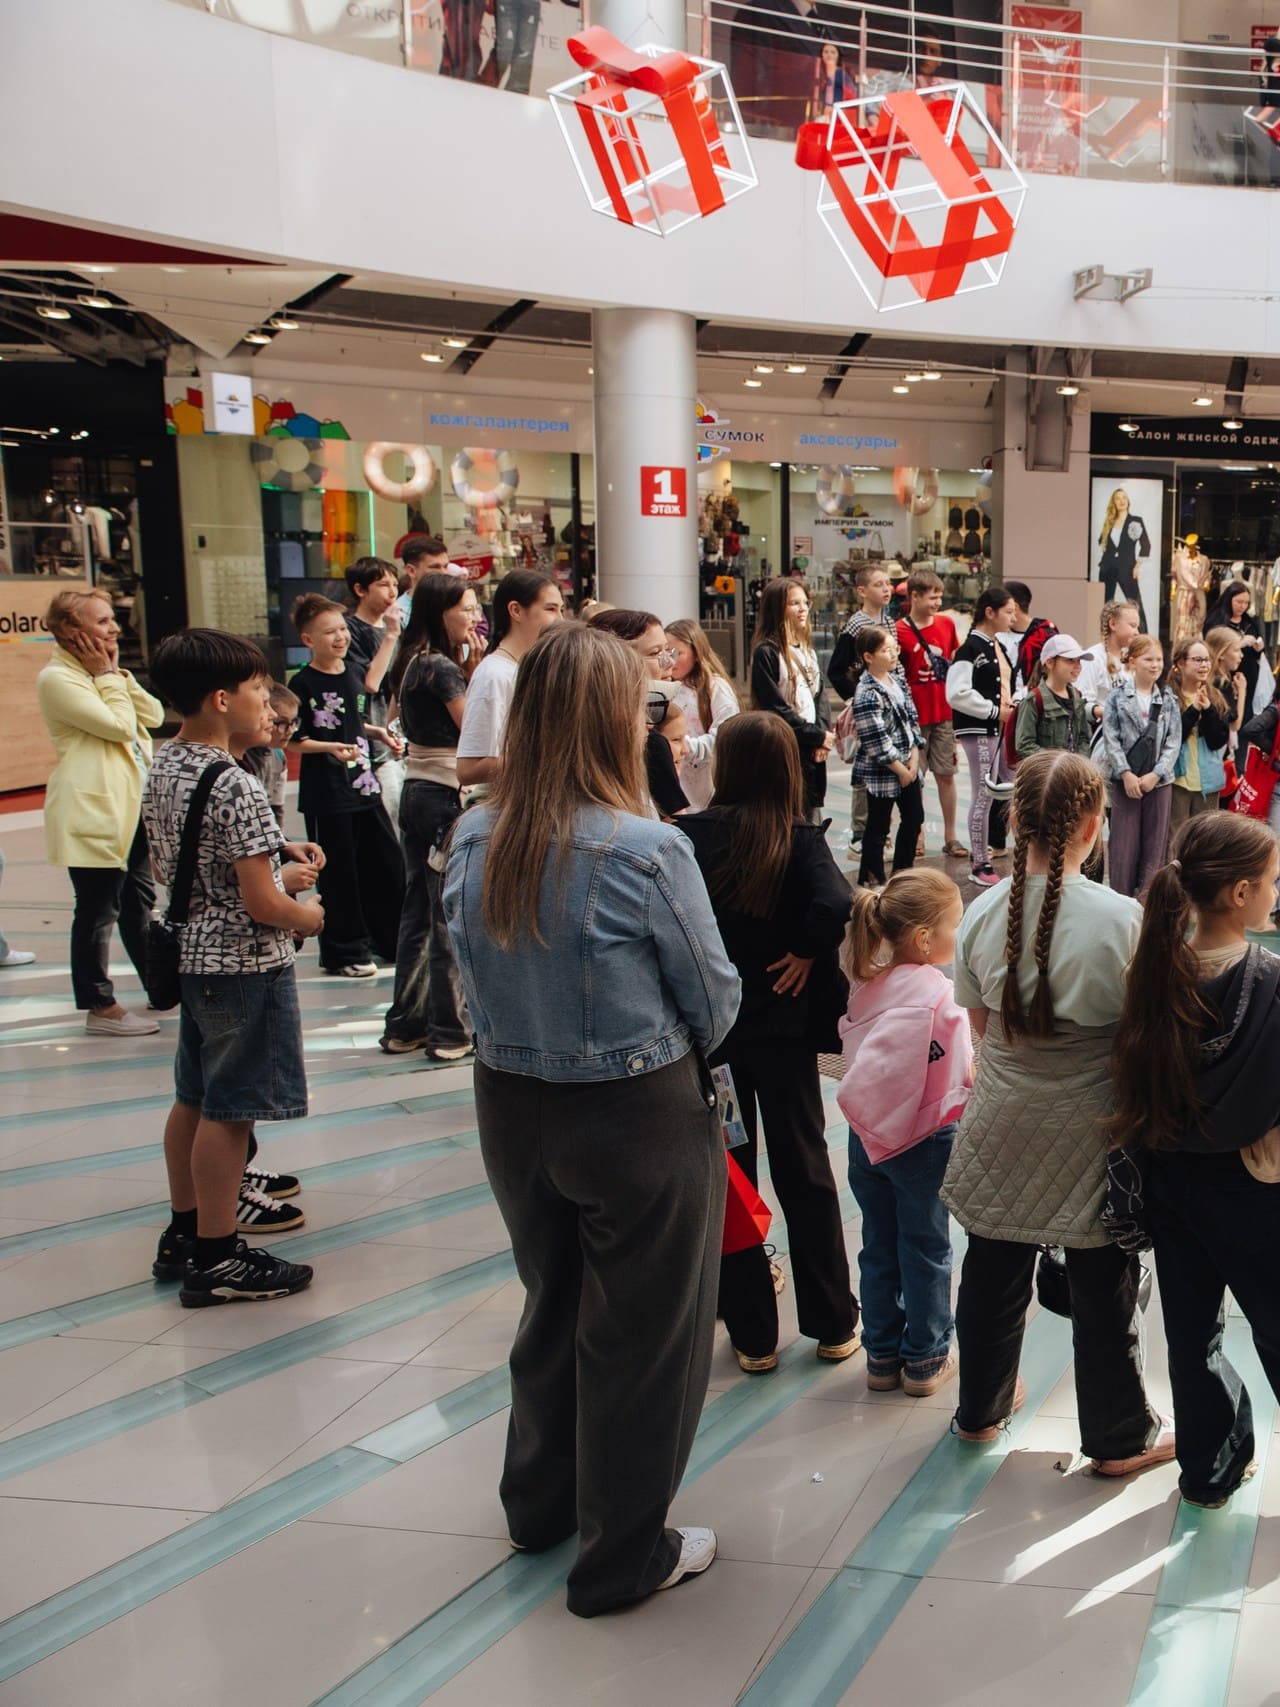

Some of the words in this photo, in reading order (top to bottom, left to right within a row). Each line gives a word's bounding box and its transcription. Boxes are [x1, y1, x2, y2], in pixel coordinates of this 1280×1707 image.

[429, 413, 570, 434] кожгалантерея
[799, 433, 897, 451] аксессуары
[1128, 431, 1171, 441] САЛОН
[1176, 433, 1238, 444] ЖЕНСКОЙ
[653, 469, 679, 503] 1
[650, 503, 681, 515] этаж
[814, 519, 859, 527] ИМПЕРИЯ
